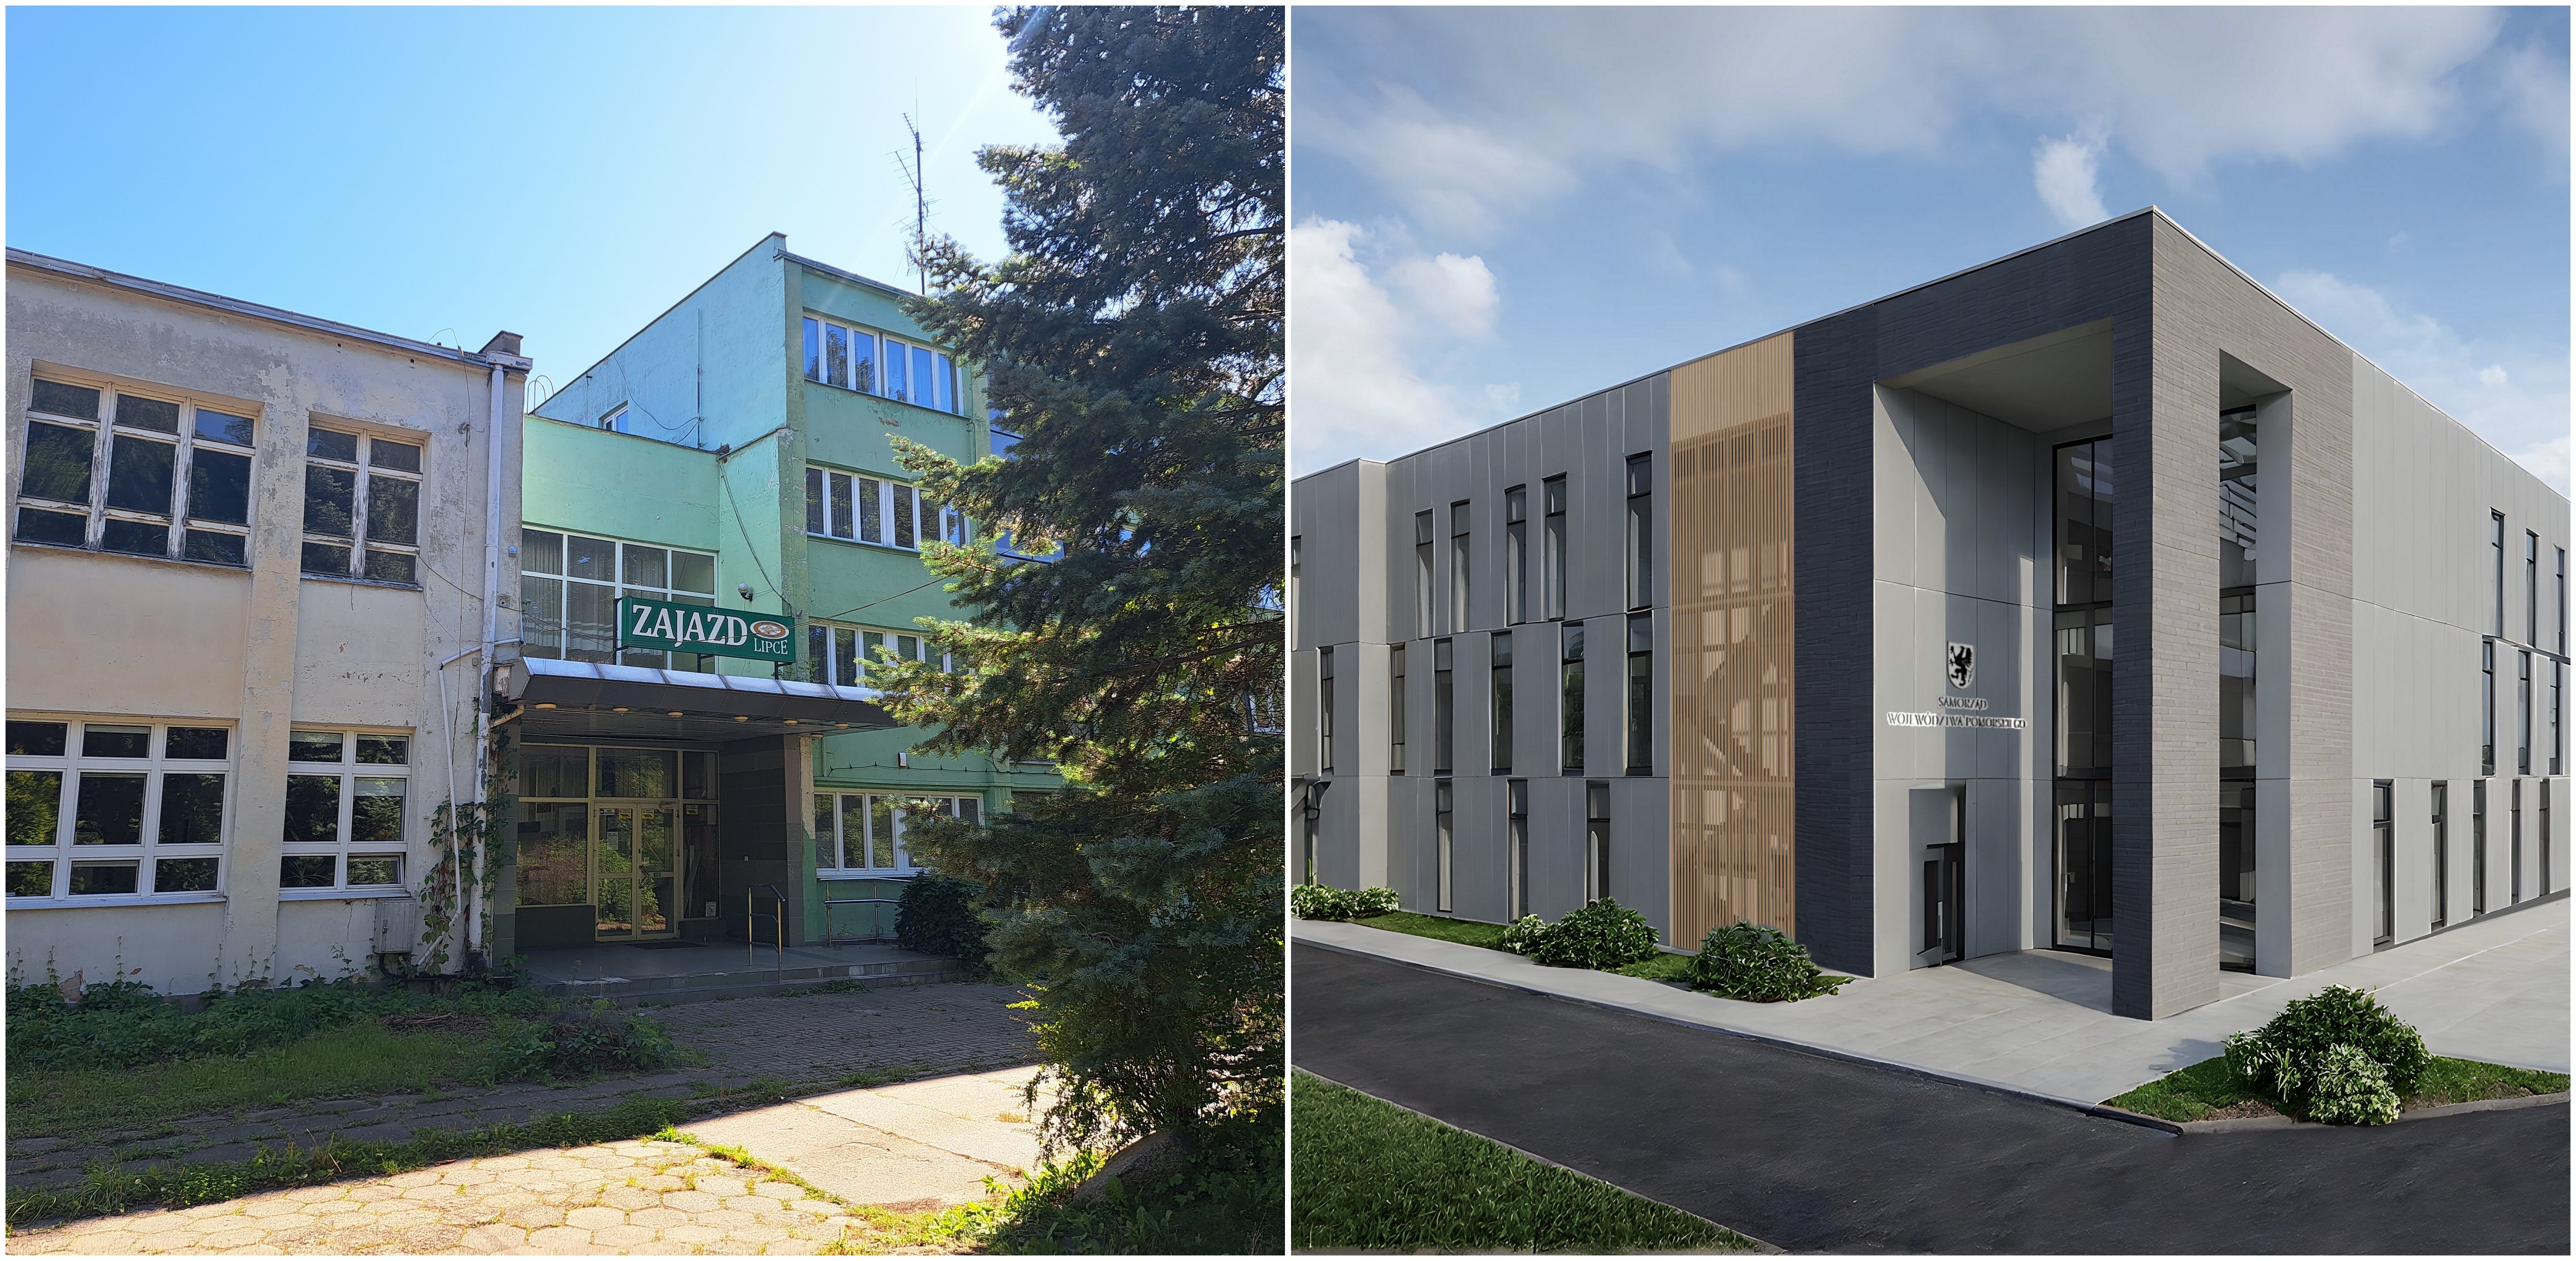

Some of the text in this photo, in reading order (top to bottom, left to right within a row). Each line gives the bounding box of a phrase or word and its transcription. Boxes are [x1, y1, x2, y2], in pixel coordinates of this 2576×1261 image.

[632, 604, 748, 647] ZAJAZD
[754, 637, 788, 654] LIPCE
[1938, 696, 1987, 710] SAMORZĄD
